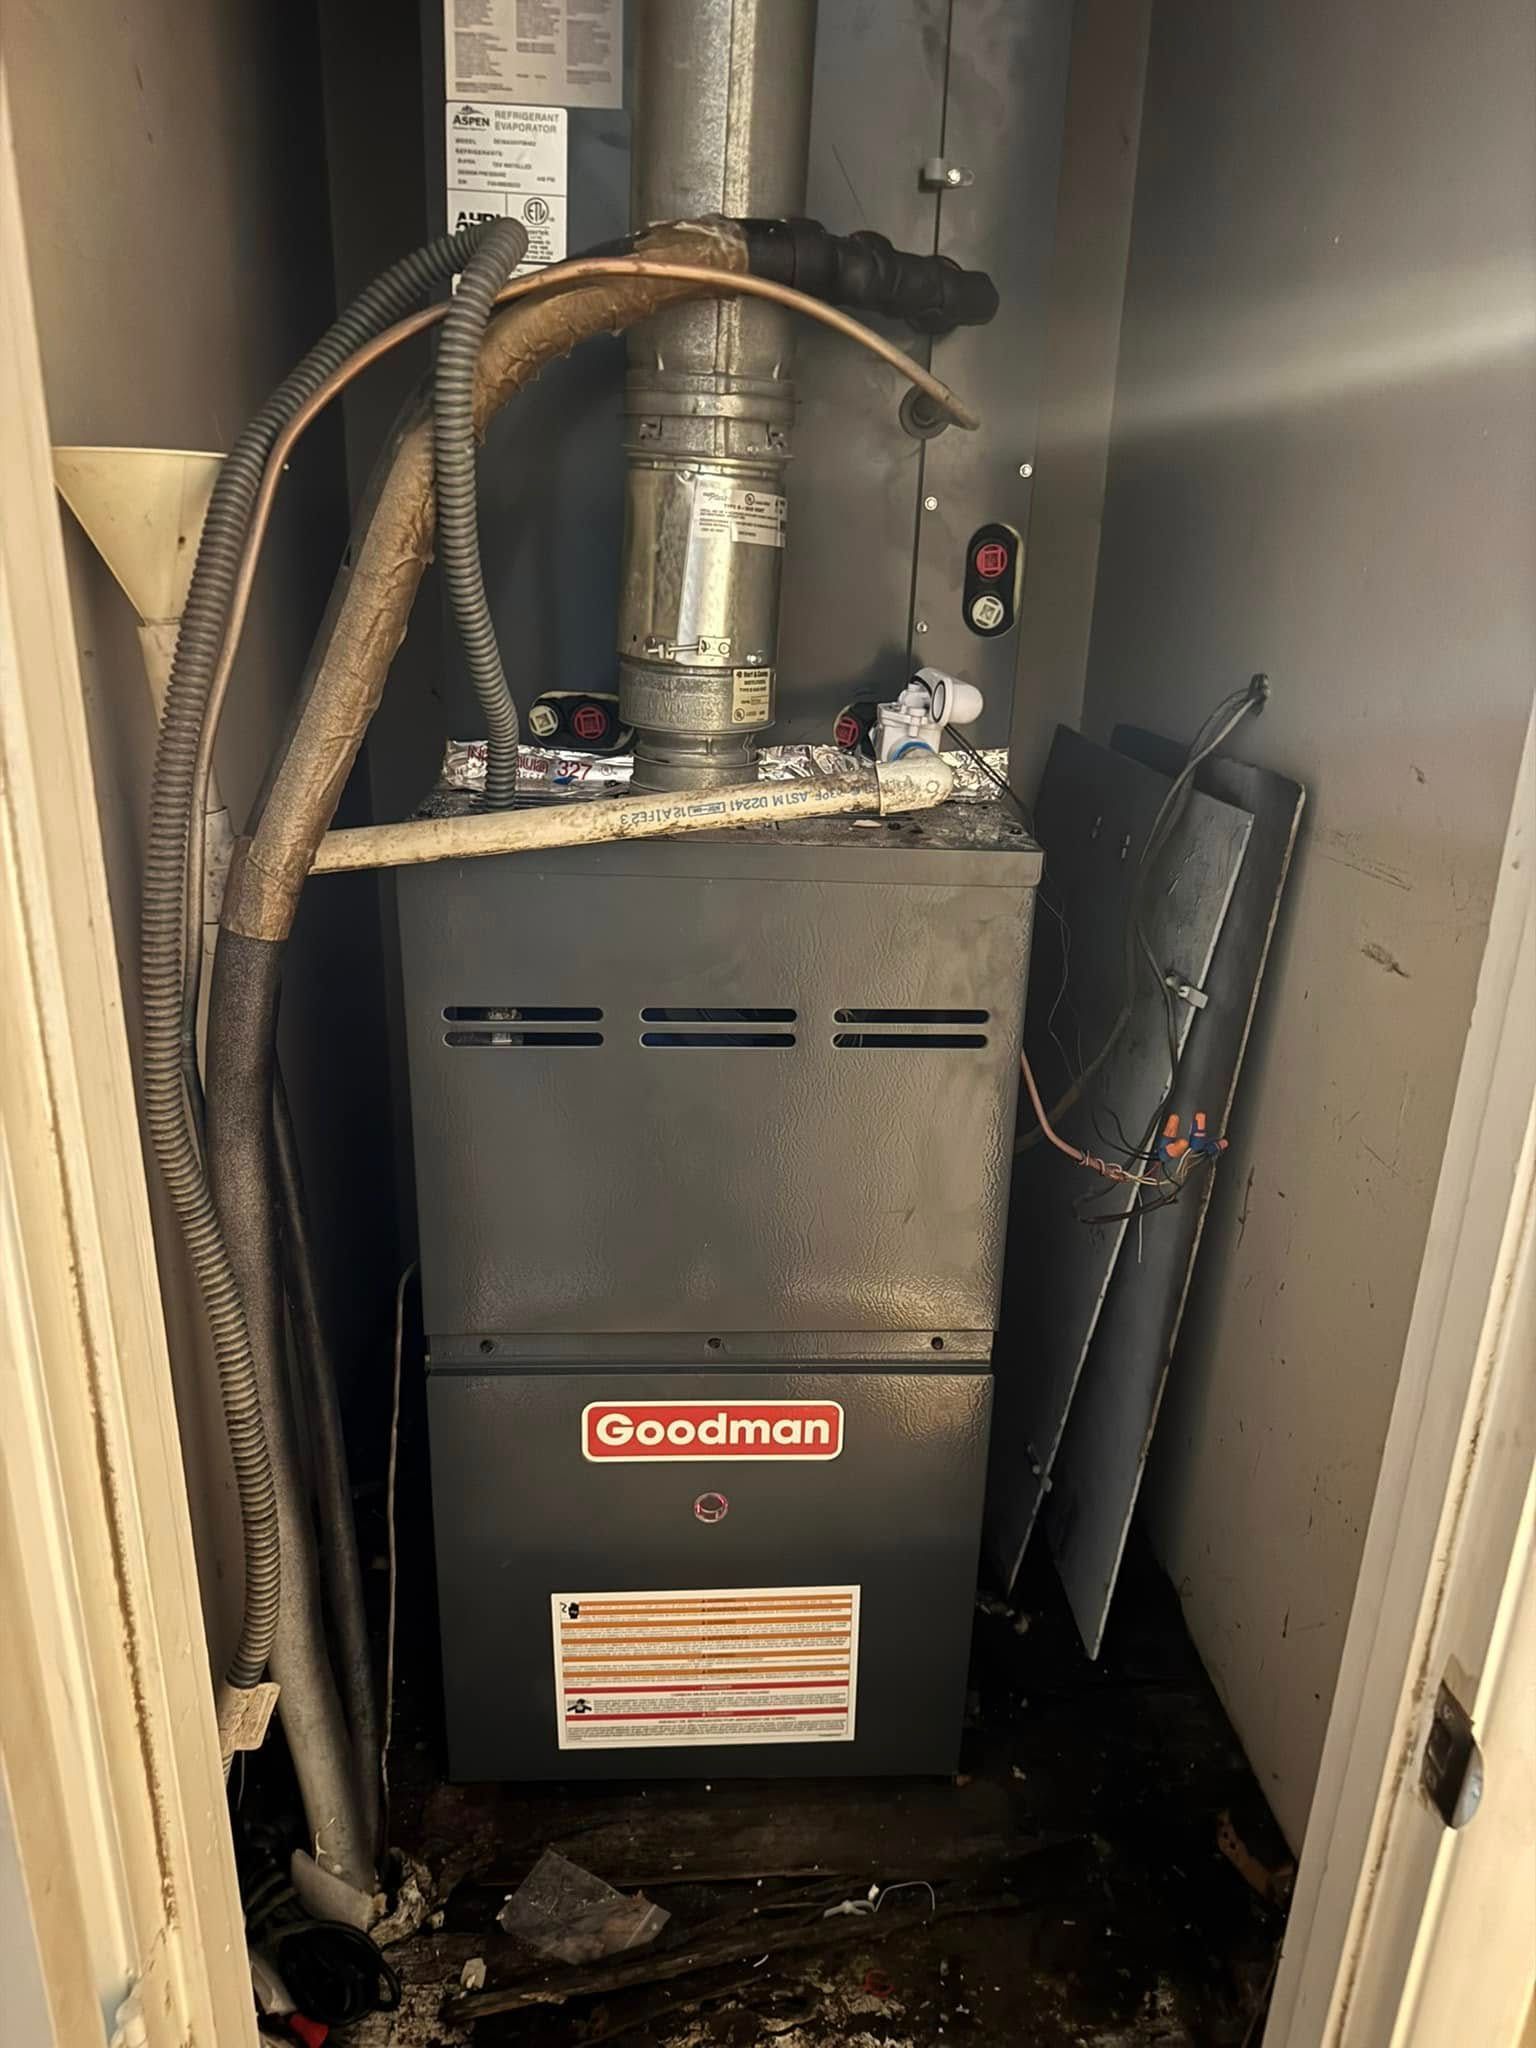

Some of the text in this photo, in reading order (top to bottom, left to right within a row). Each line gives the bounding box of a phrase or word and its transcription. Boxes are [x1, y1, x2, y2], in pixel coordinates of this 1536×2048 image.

[452, 114, 490, 127] ASPEN
[494, 110, 560, 123] REFRIGERANT
[494, 121, 557, 133] EVAPORATOR
[557, 760, 593, 780] 327
[730, 796, 768, 811] D2241
[772, 790, 808, 807] ASTM
[596, 1412, 830, 1446] Goodman
